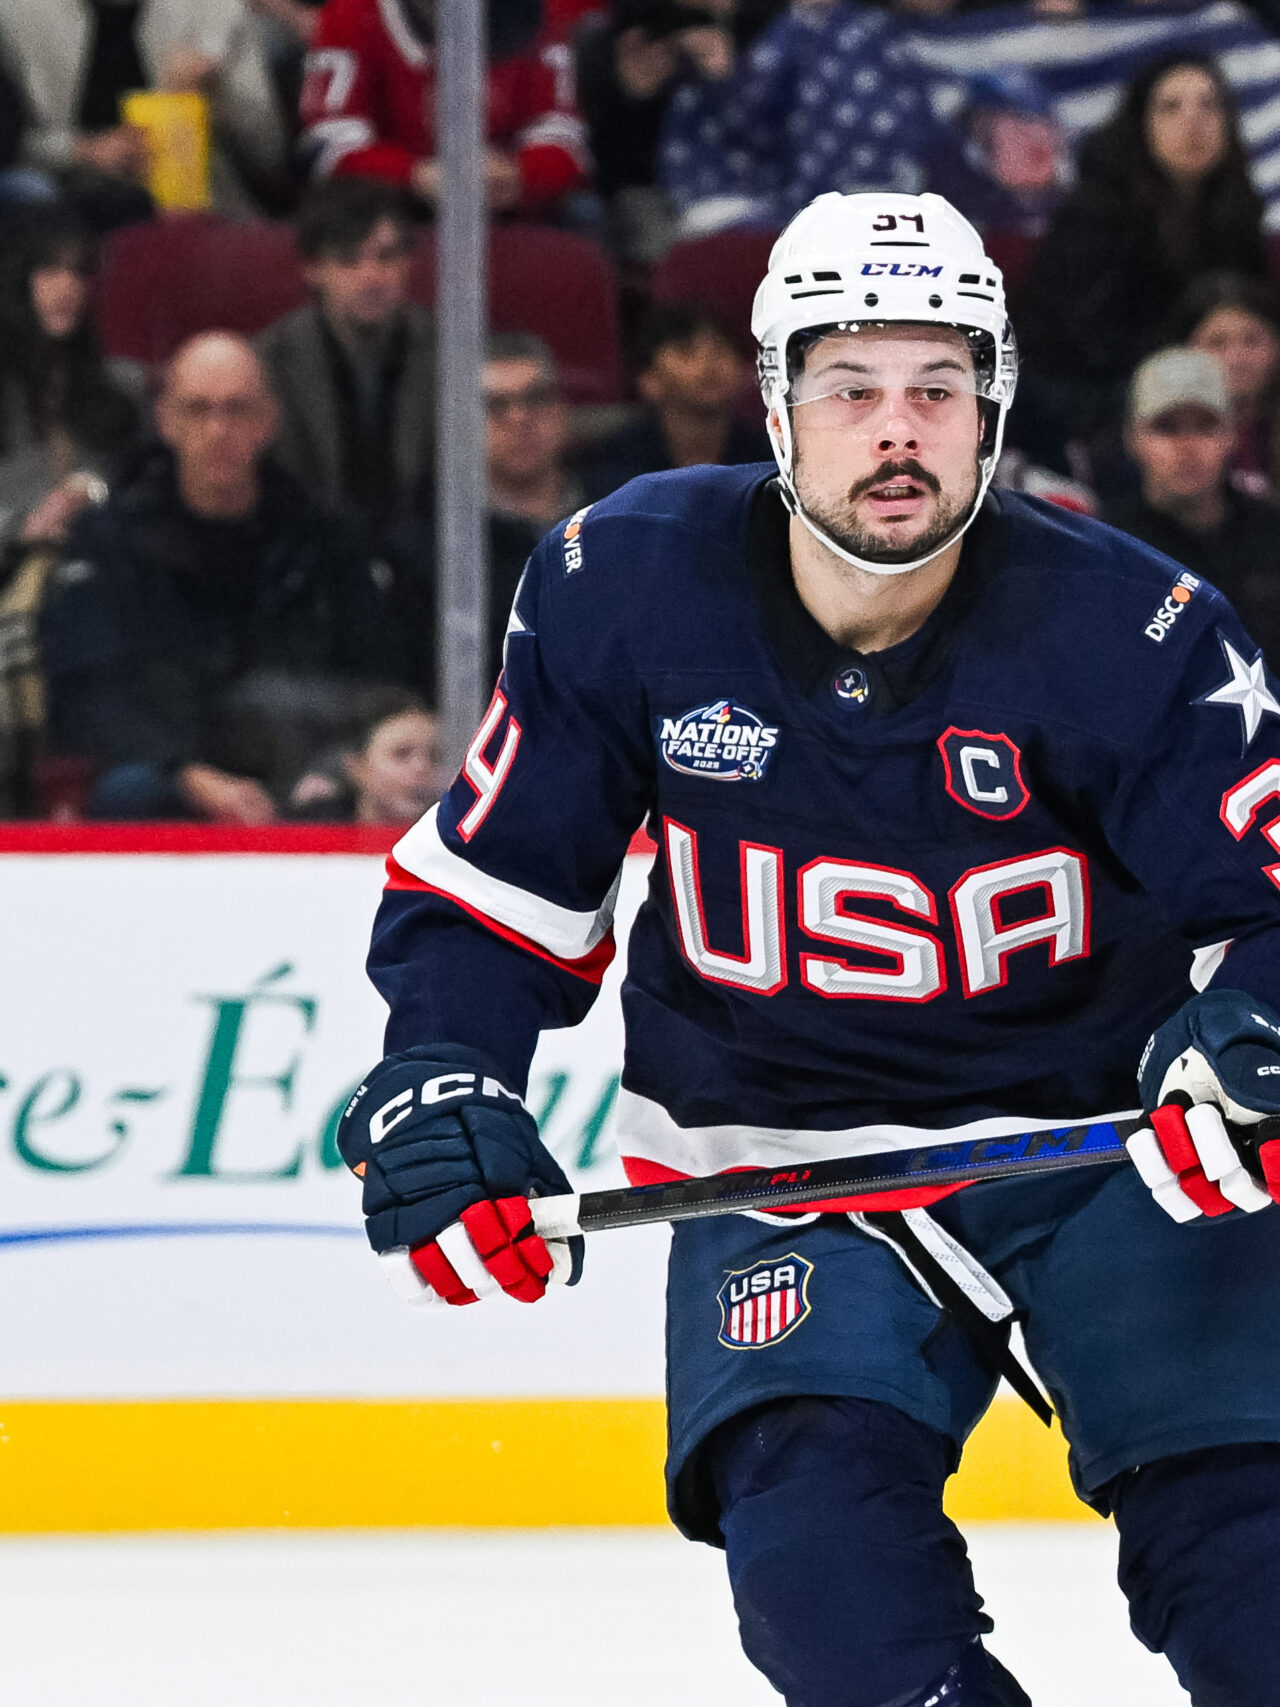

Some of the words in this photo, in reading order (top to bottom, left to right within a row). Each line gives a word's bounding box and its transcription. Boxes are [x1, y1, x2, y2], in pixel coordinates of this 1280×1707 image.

[860, 263, 943, 277] CCM
[660, 719, 779, 747] NATIONS
[959, 745, 1008, 803] C
[663, 814, 1091, 1002] USA
[730, 1265, 796, 1303] USA
